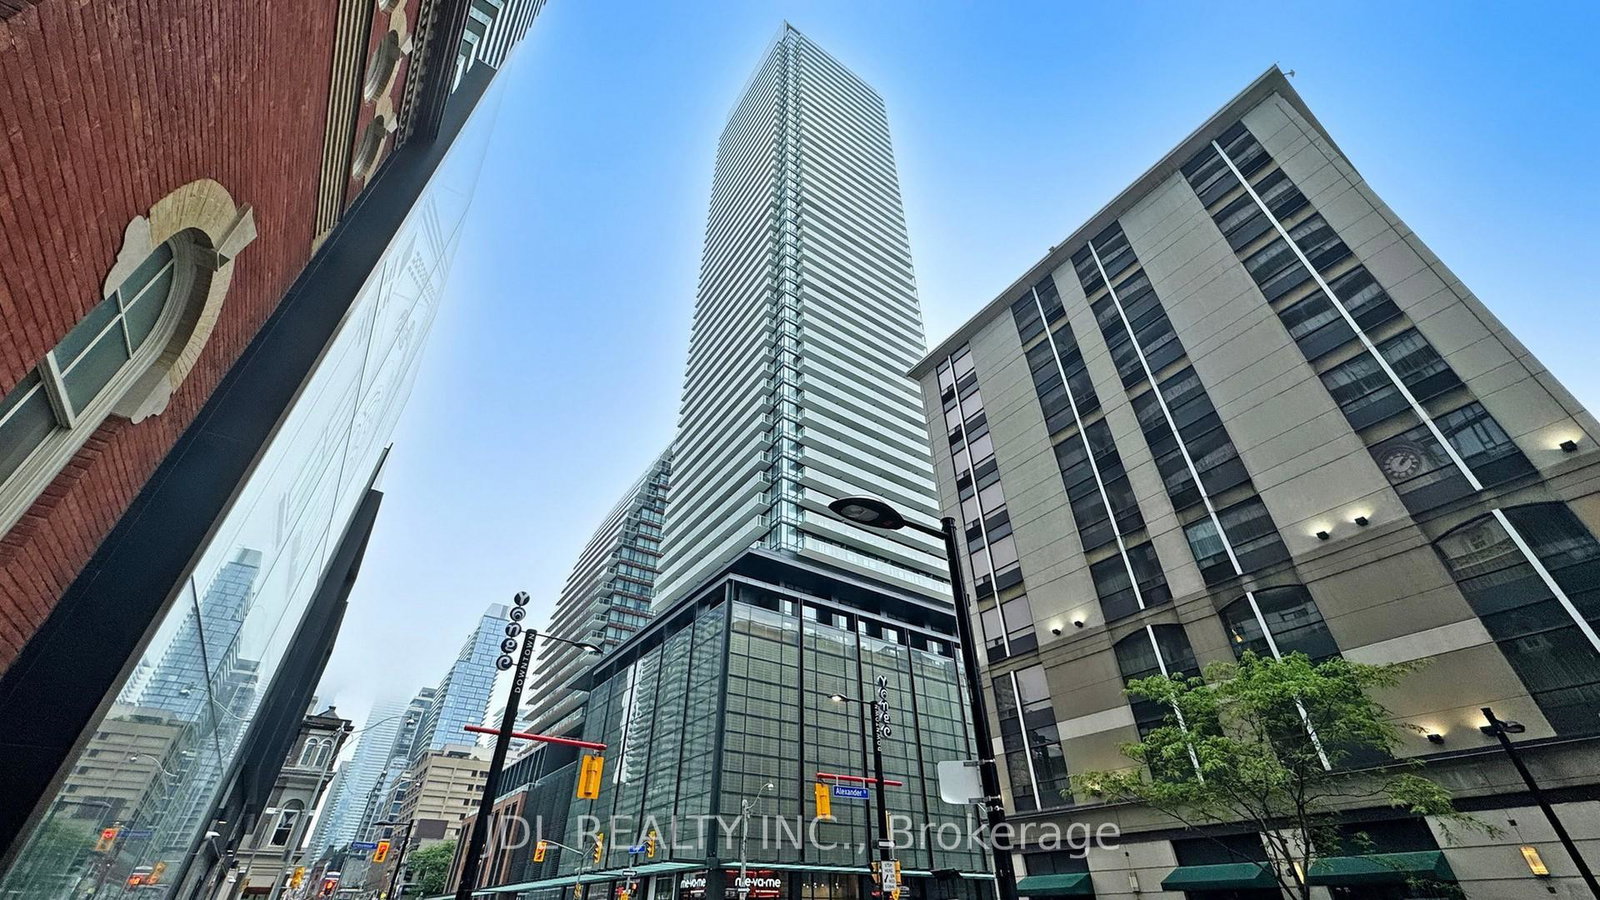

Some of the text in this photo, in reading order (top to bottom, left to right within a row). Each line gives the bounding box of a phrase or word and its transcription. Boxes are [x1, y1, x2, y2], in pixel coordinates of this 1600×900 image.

[496, 591, 530, 671] Yonge
[514, 633, 536, 694] DOWNTOWN
[835, 787, 862, 797] Alexander
